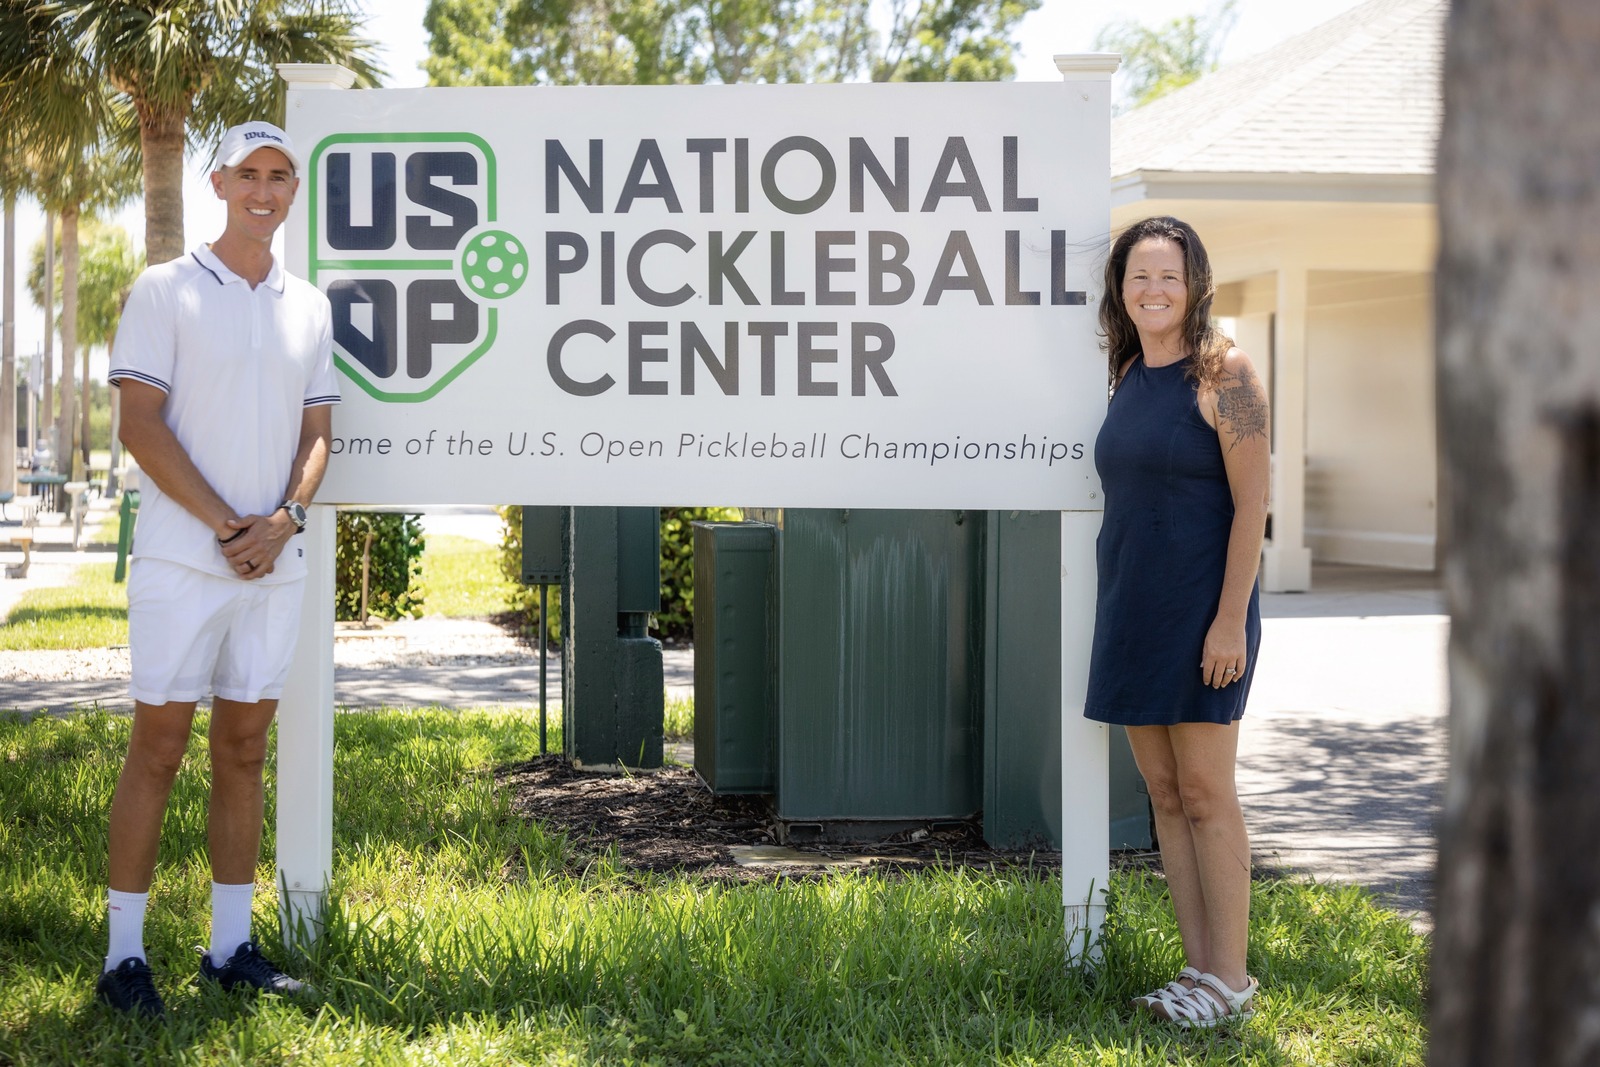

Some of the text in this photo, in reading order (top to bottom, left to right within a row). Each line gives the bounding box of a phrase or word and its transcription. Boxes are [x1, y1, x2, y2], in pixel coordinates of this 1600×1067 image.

[244, 131, 283, 143] Wilson
[545, 135, 1039, 215] NATIONAL
[326, 151, 478, 251] US
[545, 229, 1087, 307] PICKLEBALL
[546, 319, 899, 397] CENTER
[330, 429, 1085, 467] ome of the U.S. Open Pickleball Championships
